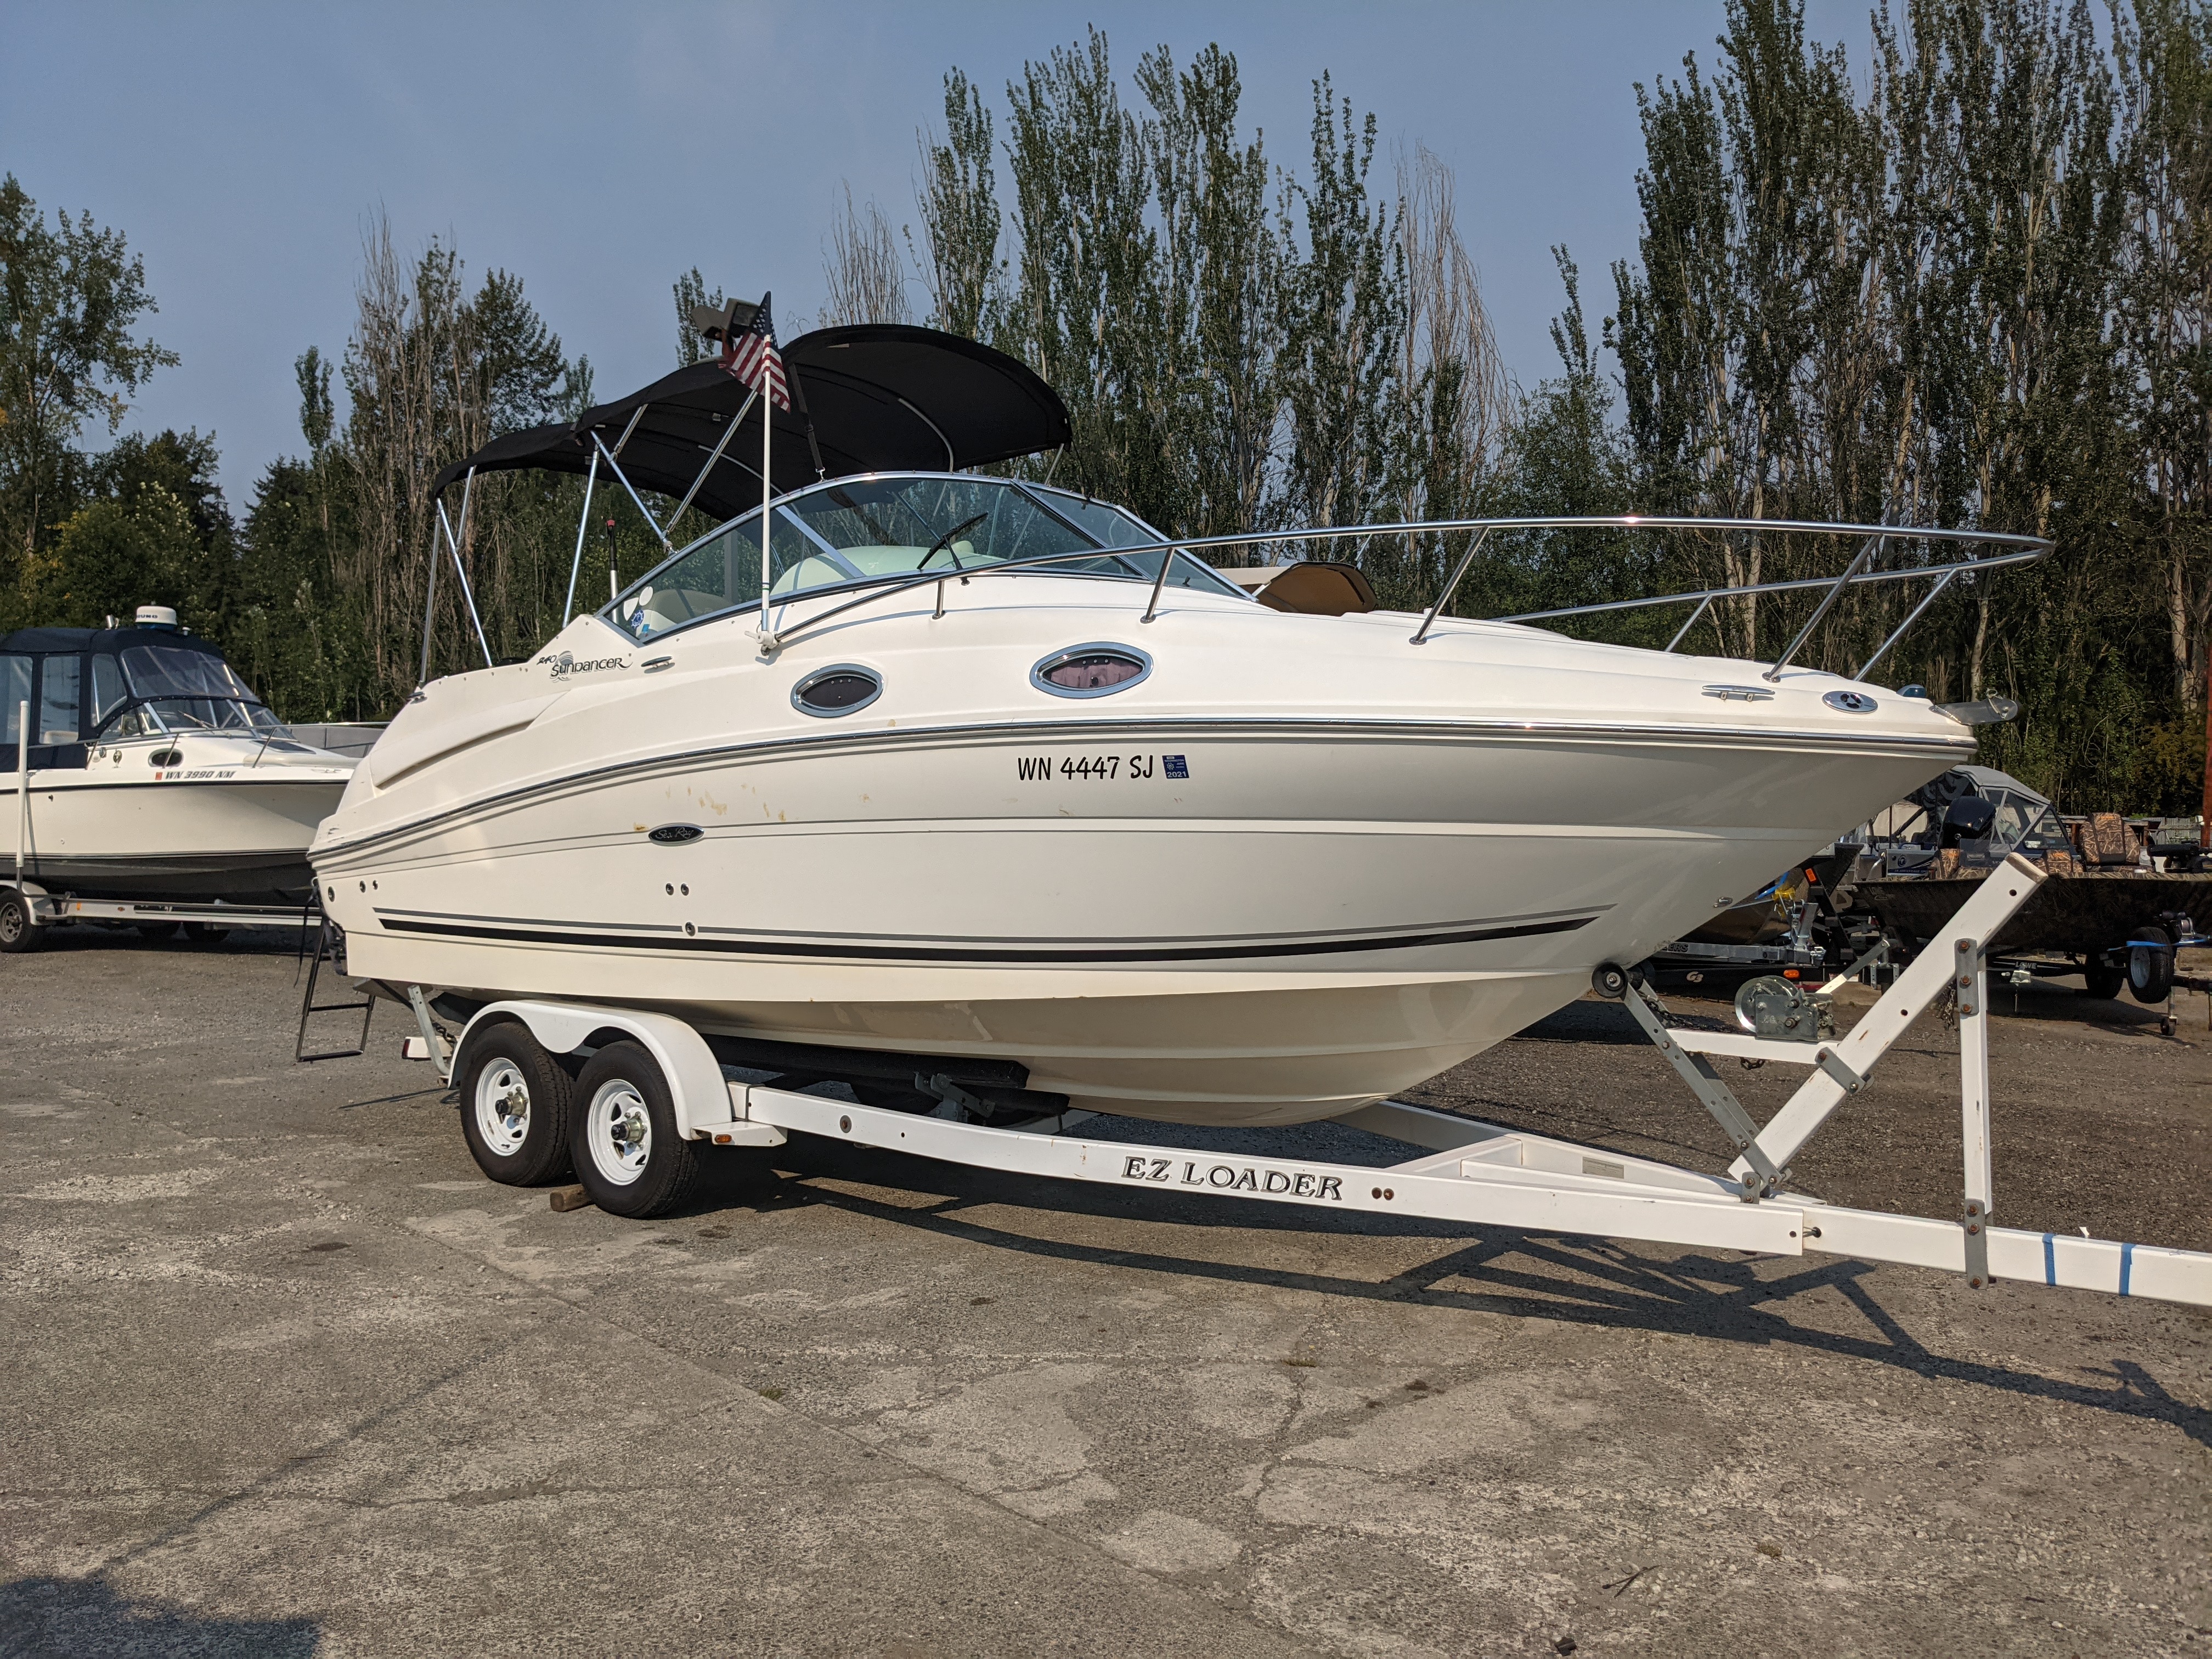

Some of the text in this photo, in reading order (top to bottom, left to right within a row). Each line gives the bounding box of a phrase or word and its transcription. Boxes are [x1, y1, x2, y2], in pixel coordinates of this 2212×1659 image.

[537, 654, 557, 665] 240
[1018, 754, 1153, 781] WN 4447 SJ
[655, 827, 694, 839] Sea Ray
[1686, 971, 1703, 983] G3
[1121, 1156, 1343, 1201] EZ LOADER
